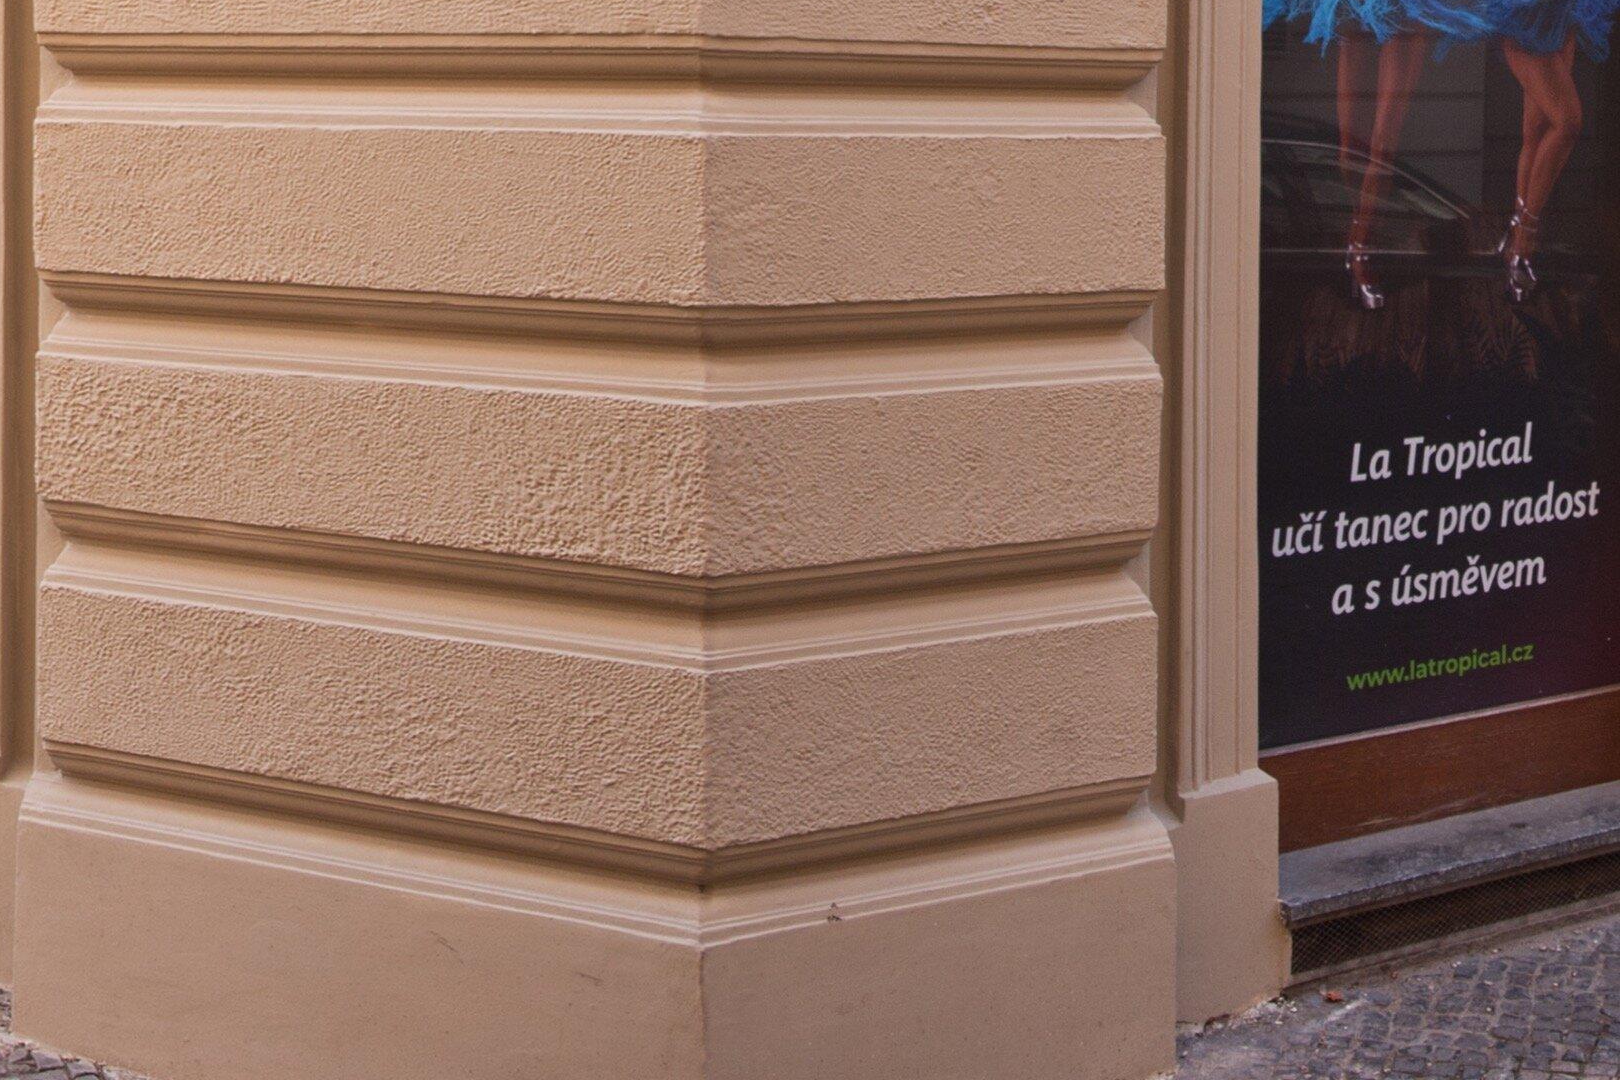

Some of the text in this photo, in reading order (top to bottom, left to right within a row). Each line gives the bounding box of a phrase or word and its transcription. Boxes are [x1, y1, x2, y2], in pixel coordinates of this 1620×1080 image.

[1350, 421, 1532, 482] La Tropical
[1272, 480, 1600, 557] učí tanec pro radost
[1331, 554, 1547, 615] a s úsměvem
[1346, 644, 1534, 691] www.latropical.cz
